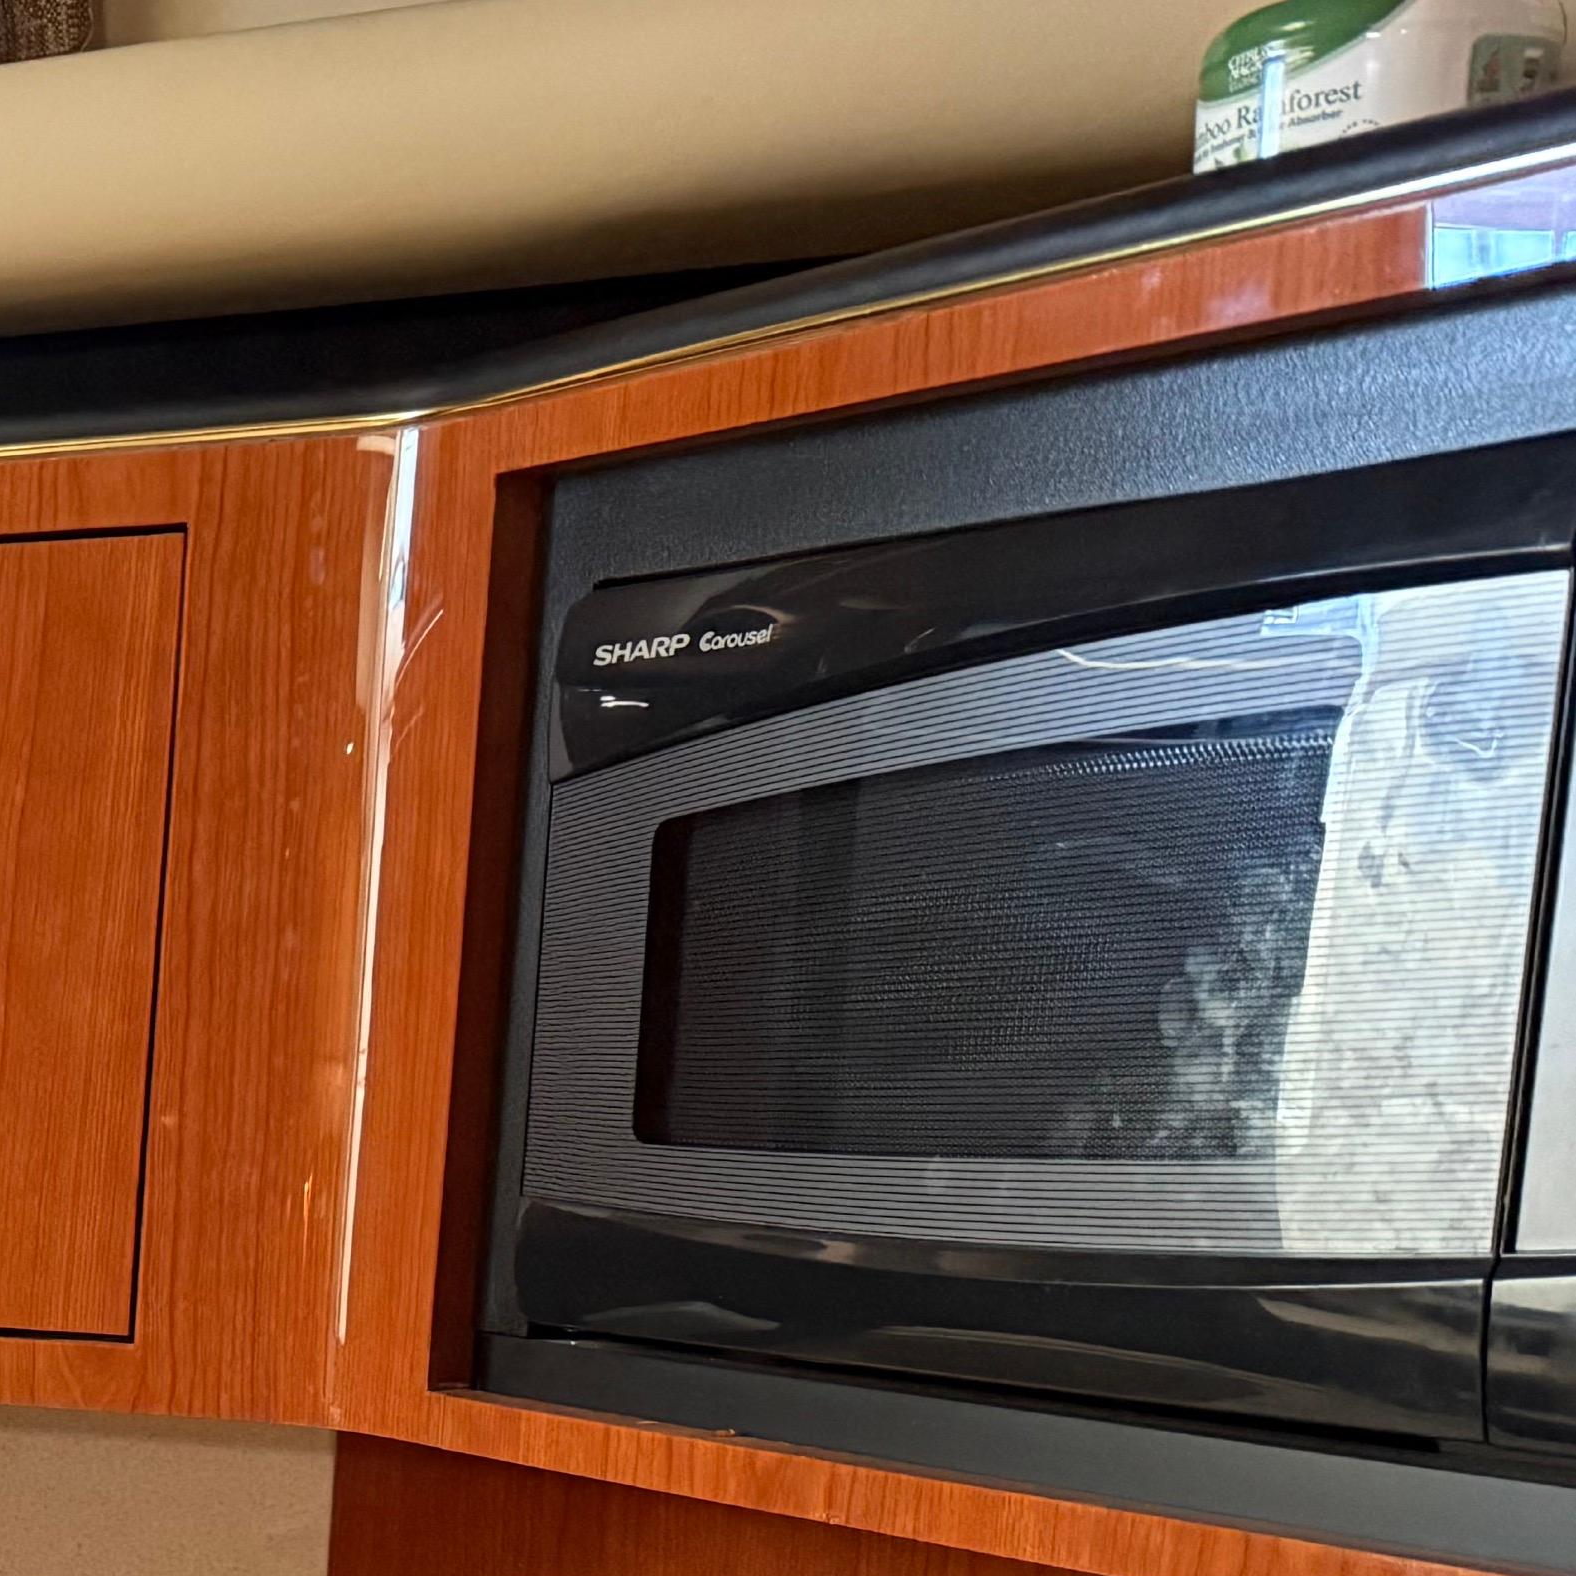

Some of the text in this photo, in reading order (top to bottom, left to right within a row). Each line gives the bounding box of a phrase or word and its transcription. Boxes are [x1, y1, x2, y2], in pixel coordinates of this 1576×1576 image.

[1236, 80, 1362, 130] Raforest
[593, 623, 774, 667] SHARP Carousel
